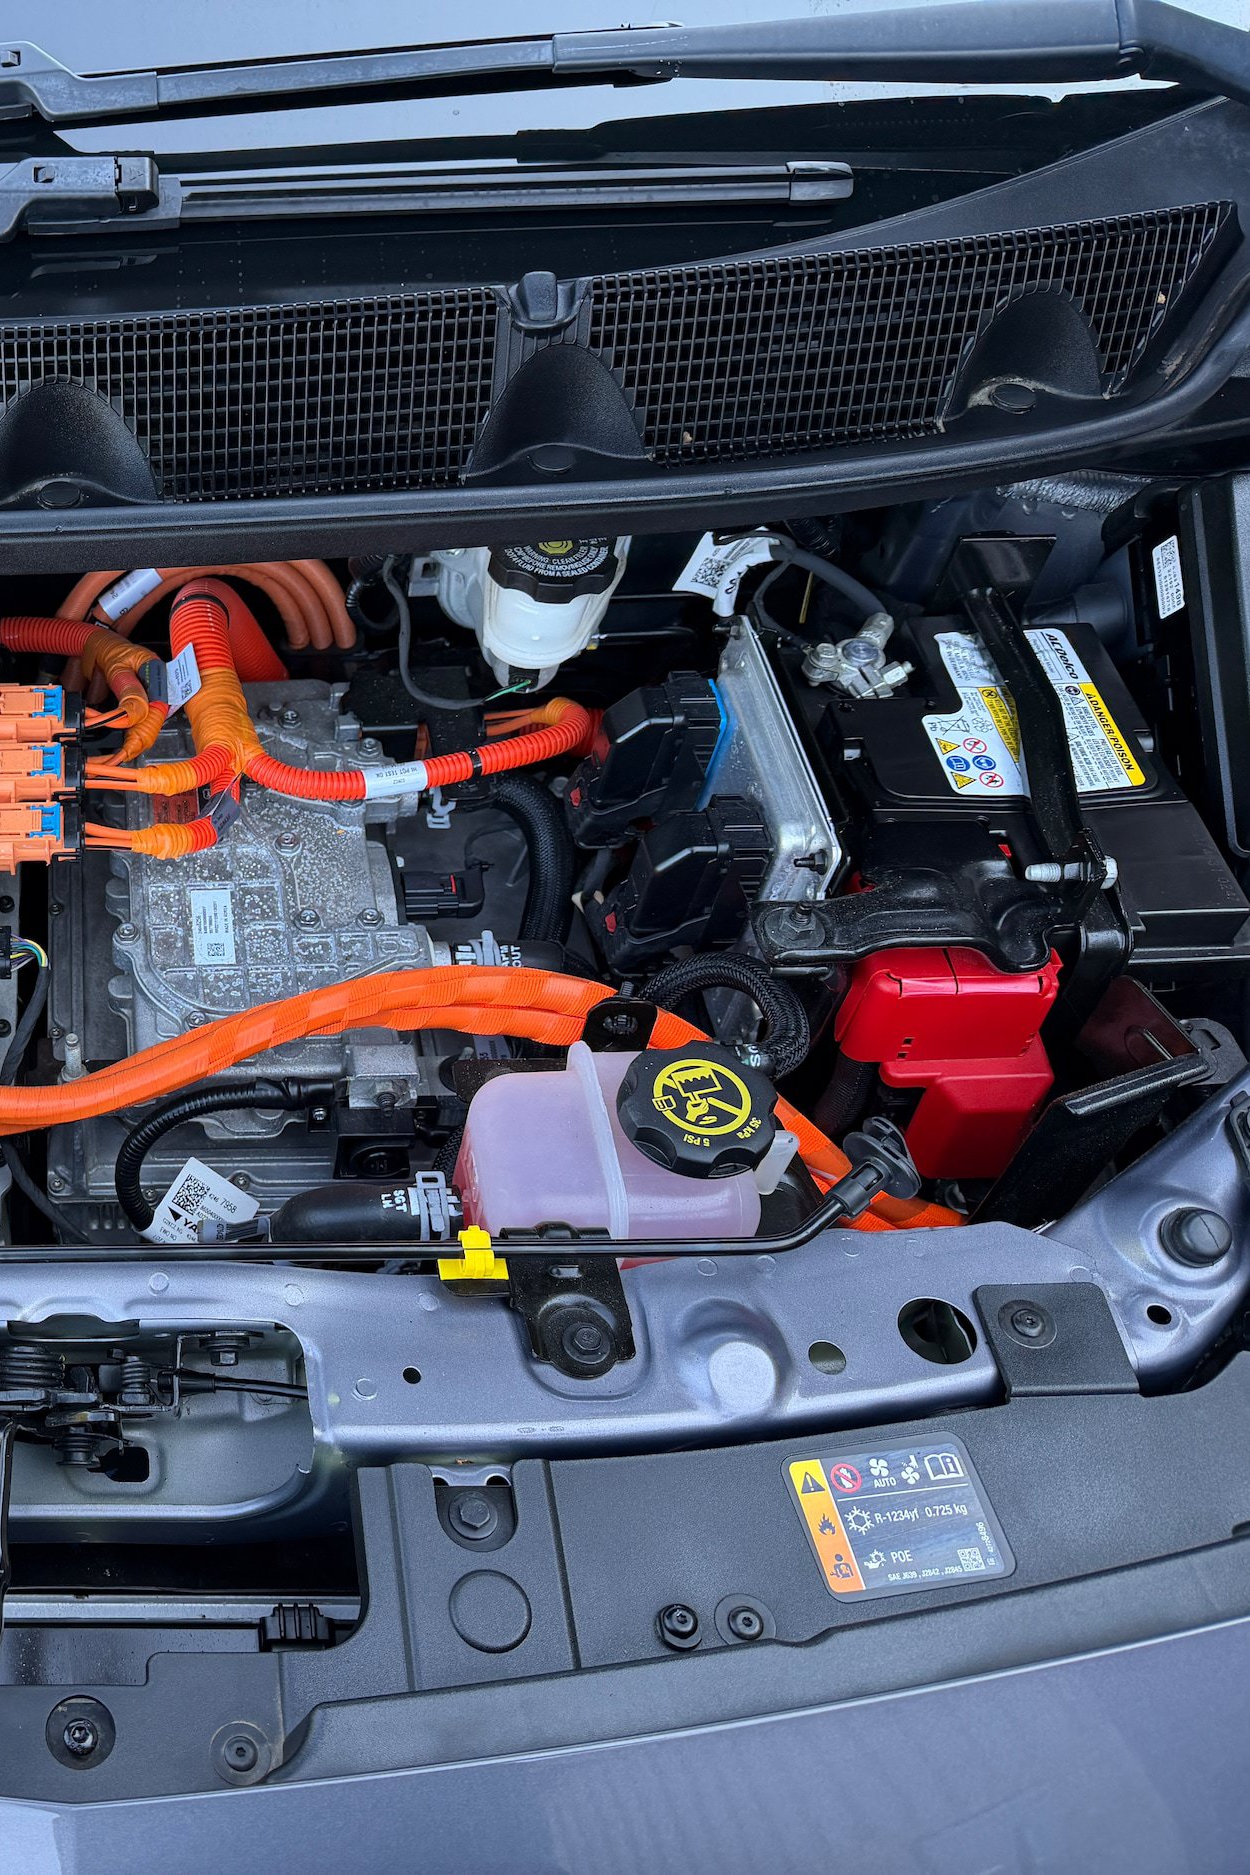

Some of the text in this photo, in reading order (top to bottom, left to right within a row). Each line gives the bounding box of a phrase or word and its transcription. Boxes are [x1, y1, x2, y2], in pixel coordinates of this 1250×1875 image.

[552, 556, 577, 565] CLEAN
[534, 567, 556, 577] FROM
[562, 567, 588, 577] SEALED
[1045, 633, 1079, 679] ACDelco
[1090, 698, 1135, 771] DANGER/POISON
[510, 945, 522, 967] OUT
[736, 1117, 763, 1140] 35 kPa
[683, 1133, 711, 1147] 5 PSI
[220, 1197, 238, 1214] 7958
[873, 1477, 897, 1488] AUTO
[874, 1503, 968, 1524] R-1234yf 0.725 kg
[890, 1550, 914, 1563] POE
[887, 1573, 901, 1581] SAE
